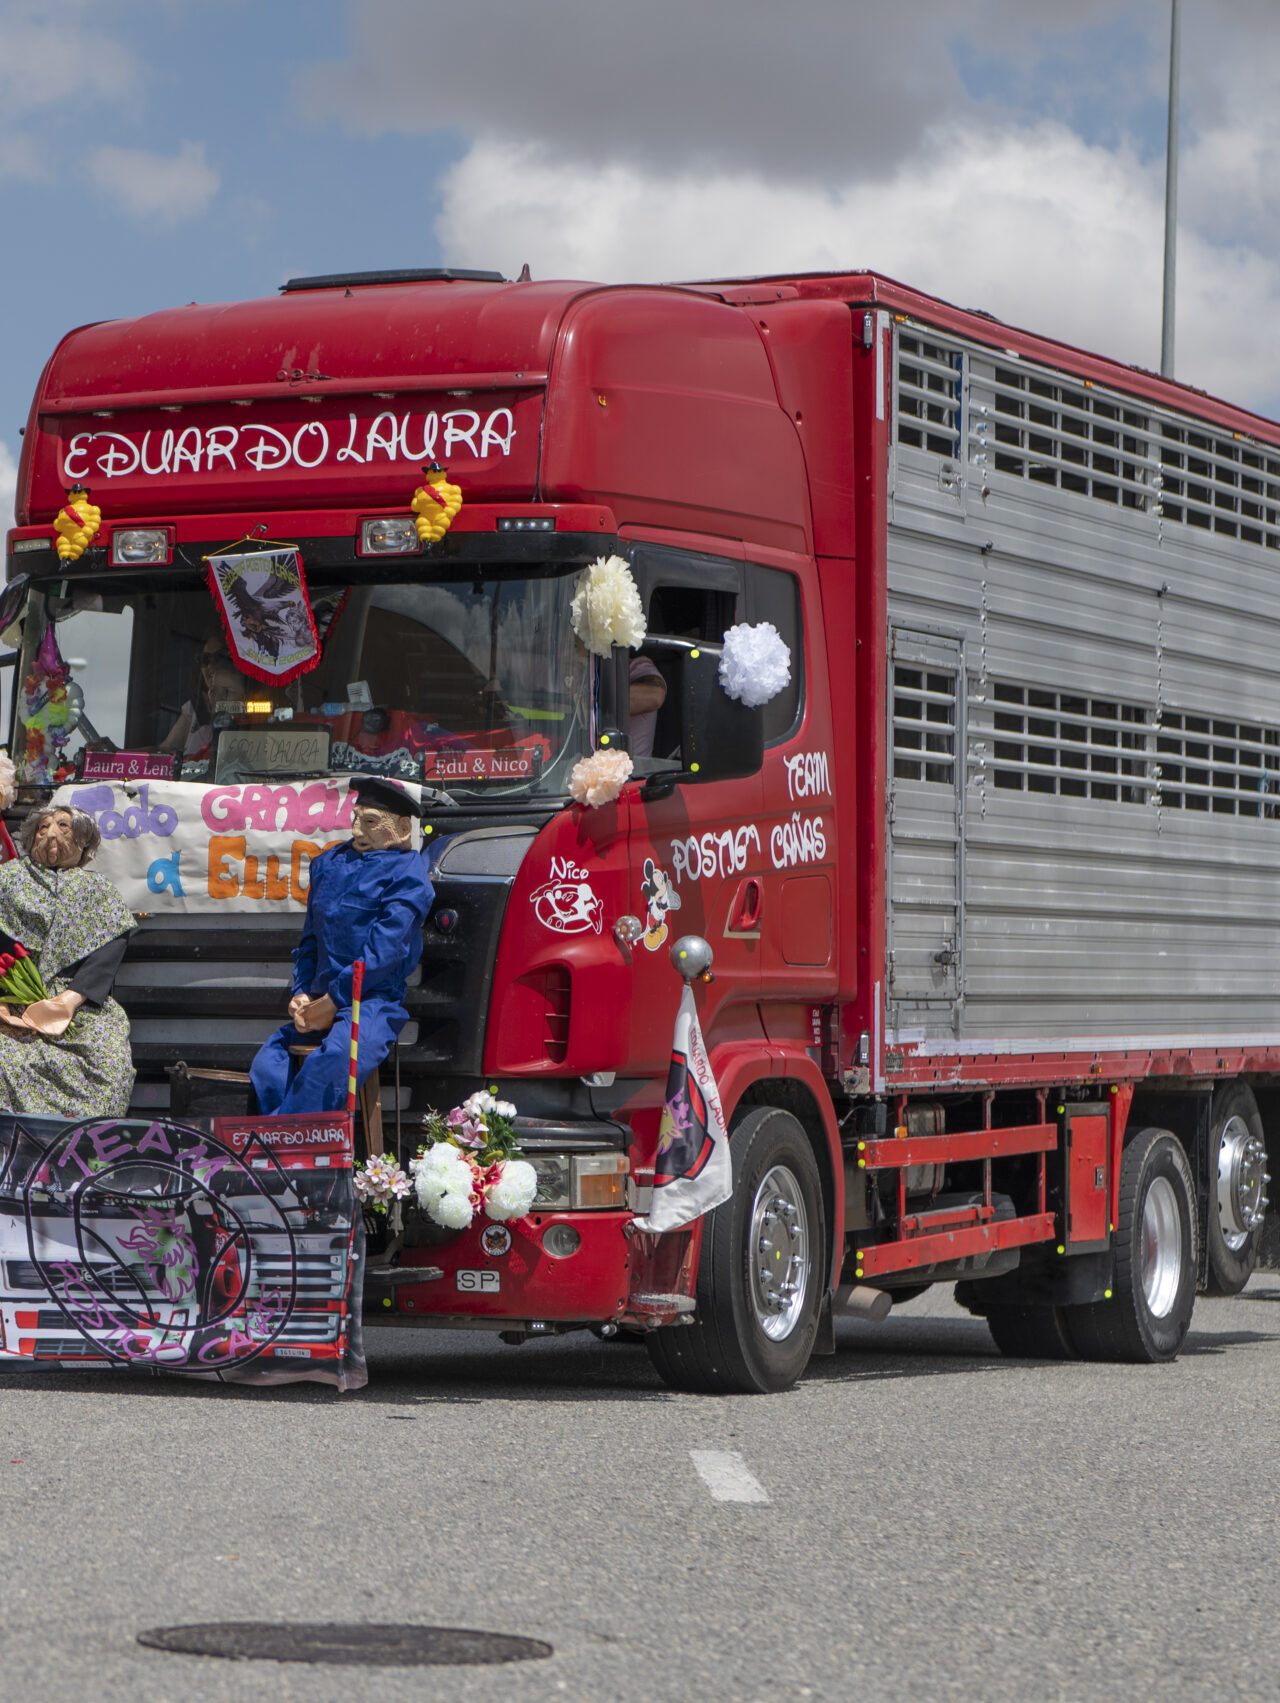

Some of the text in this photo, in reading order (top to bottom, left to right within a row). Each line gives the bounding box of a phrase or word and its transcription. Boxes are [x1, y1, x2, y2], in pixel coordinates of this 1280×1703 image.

[64, 408, 518, 478] EDUARDO LAURA
[84, 757, 124, 774] Laura
[128, 759, 140, 775] &
[436, 757, 529, 774] Edu & Nico
[784, 751, 831, 801] TEAM
[771, 811, 827, 869] CAÑAS
[550, 856, 589, 880] Nico
[690, 1026, 730, 1144] EDUARDO LAUR
[58, 1121, 231, 1183] TEAM
[306, 1128, 345, 1144] LAURA
[461, 1272, 495, 1289] SP
